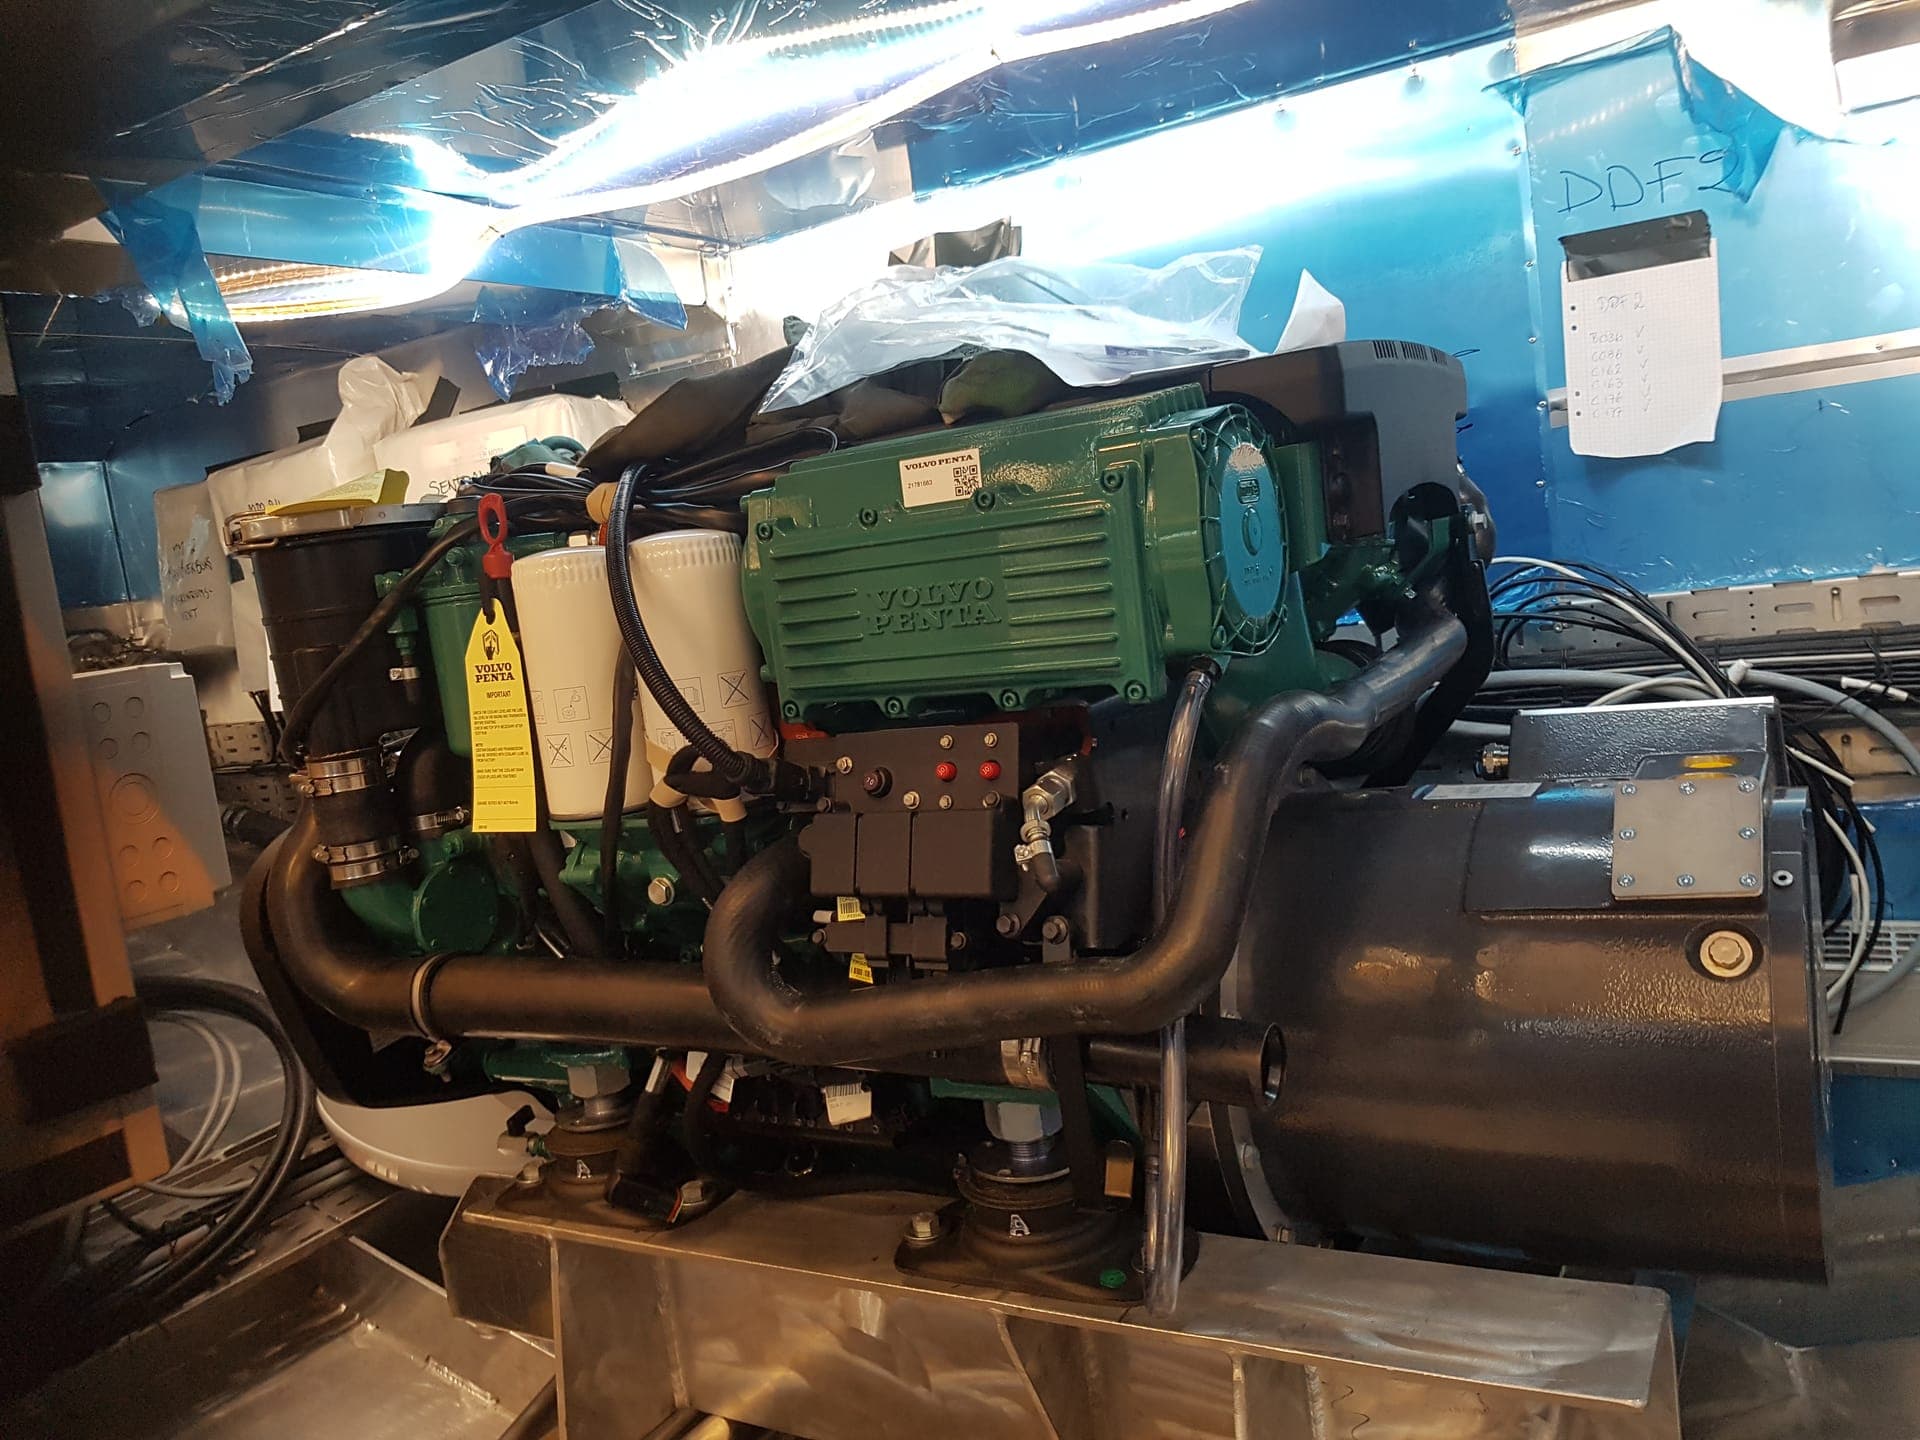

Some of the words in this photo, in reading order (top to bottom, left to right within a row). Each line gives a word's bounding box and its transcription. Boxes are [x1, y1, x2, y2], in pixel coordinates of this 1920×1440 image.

[904, 460, 937, 471] VOLVO
[938, 454, 974, 466] PENTA
[876, 577, 994, 610] VOLVO
[867, 601, 1002, 635] PENTA
[474, 662, 512, 674] VOLVO
[475, 672, 515, 683] PENTA
[486, 690, 511, 699] IMPORTANT
[1010, 1214, 1031, 1237] A
